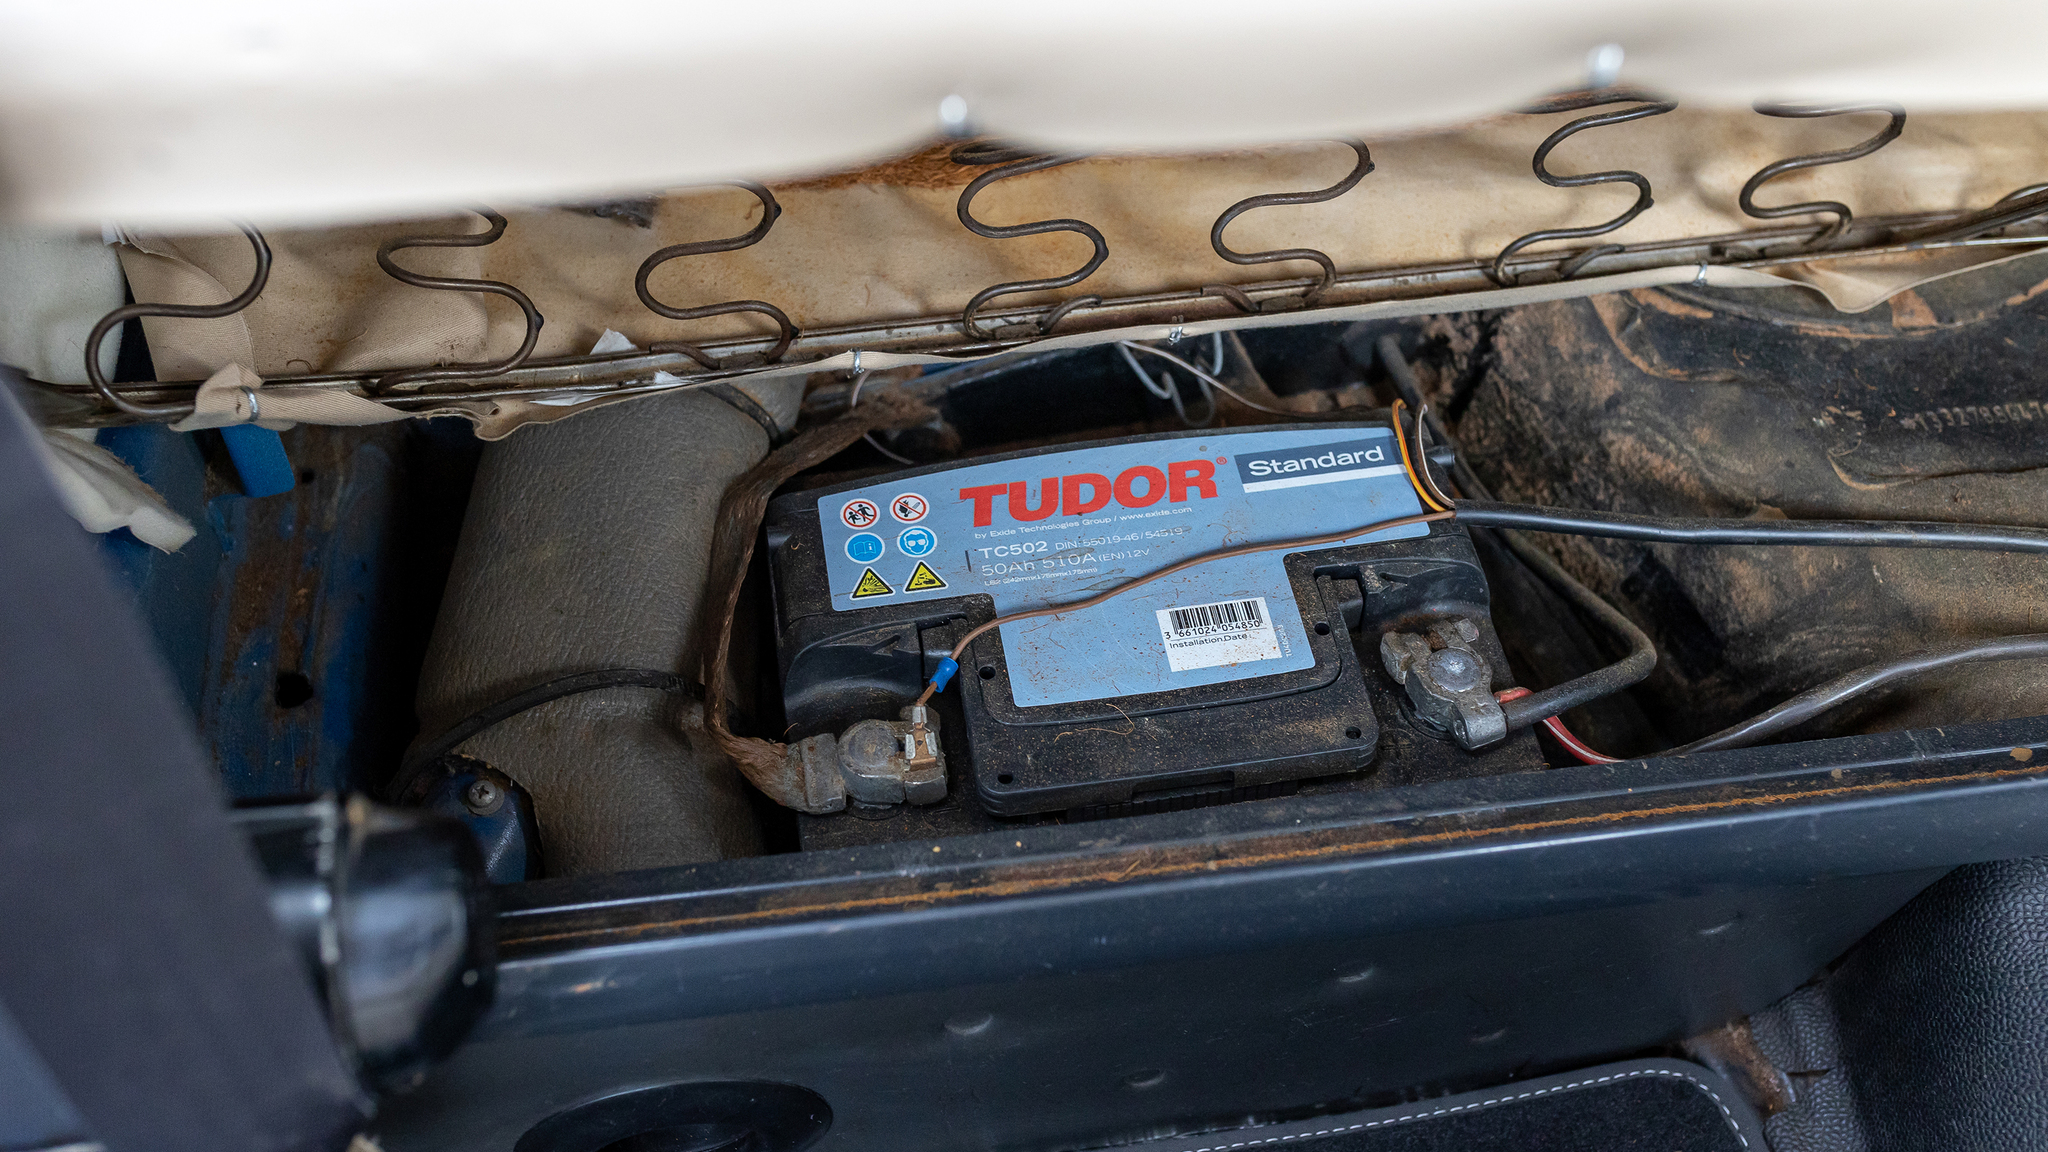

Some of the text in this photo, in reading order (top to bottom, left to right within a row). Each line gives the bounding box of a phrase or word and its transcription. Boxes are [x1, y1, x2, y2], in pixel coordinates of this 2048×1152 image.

[1248, 446, 1385, 476] Standard
[959, 459, 1218, 527] TUDOR
[974, 531, 988, 540] by
[990, 528, 1017, 538] Exide
[1018, 521, 1080, 534] Technologies
[1082, 515, 1112, 527] Group
[1119, 507, 1192, 522] www.exide.com
[978, 541, 1048, 559] TC502
[981, 560, 1035, 577] 50Ah
[1164, 620, 1260, 639] 3 661024 054850
[1169, 637, 1222, 648] Installation
